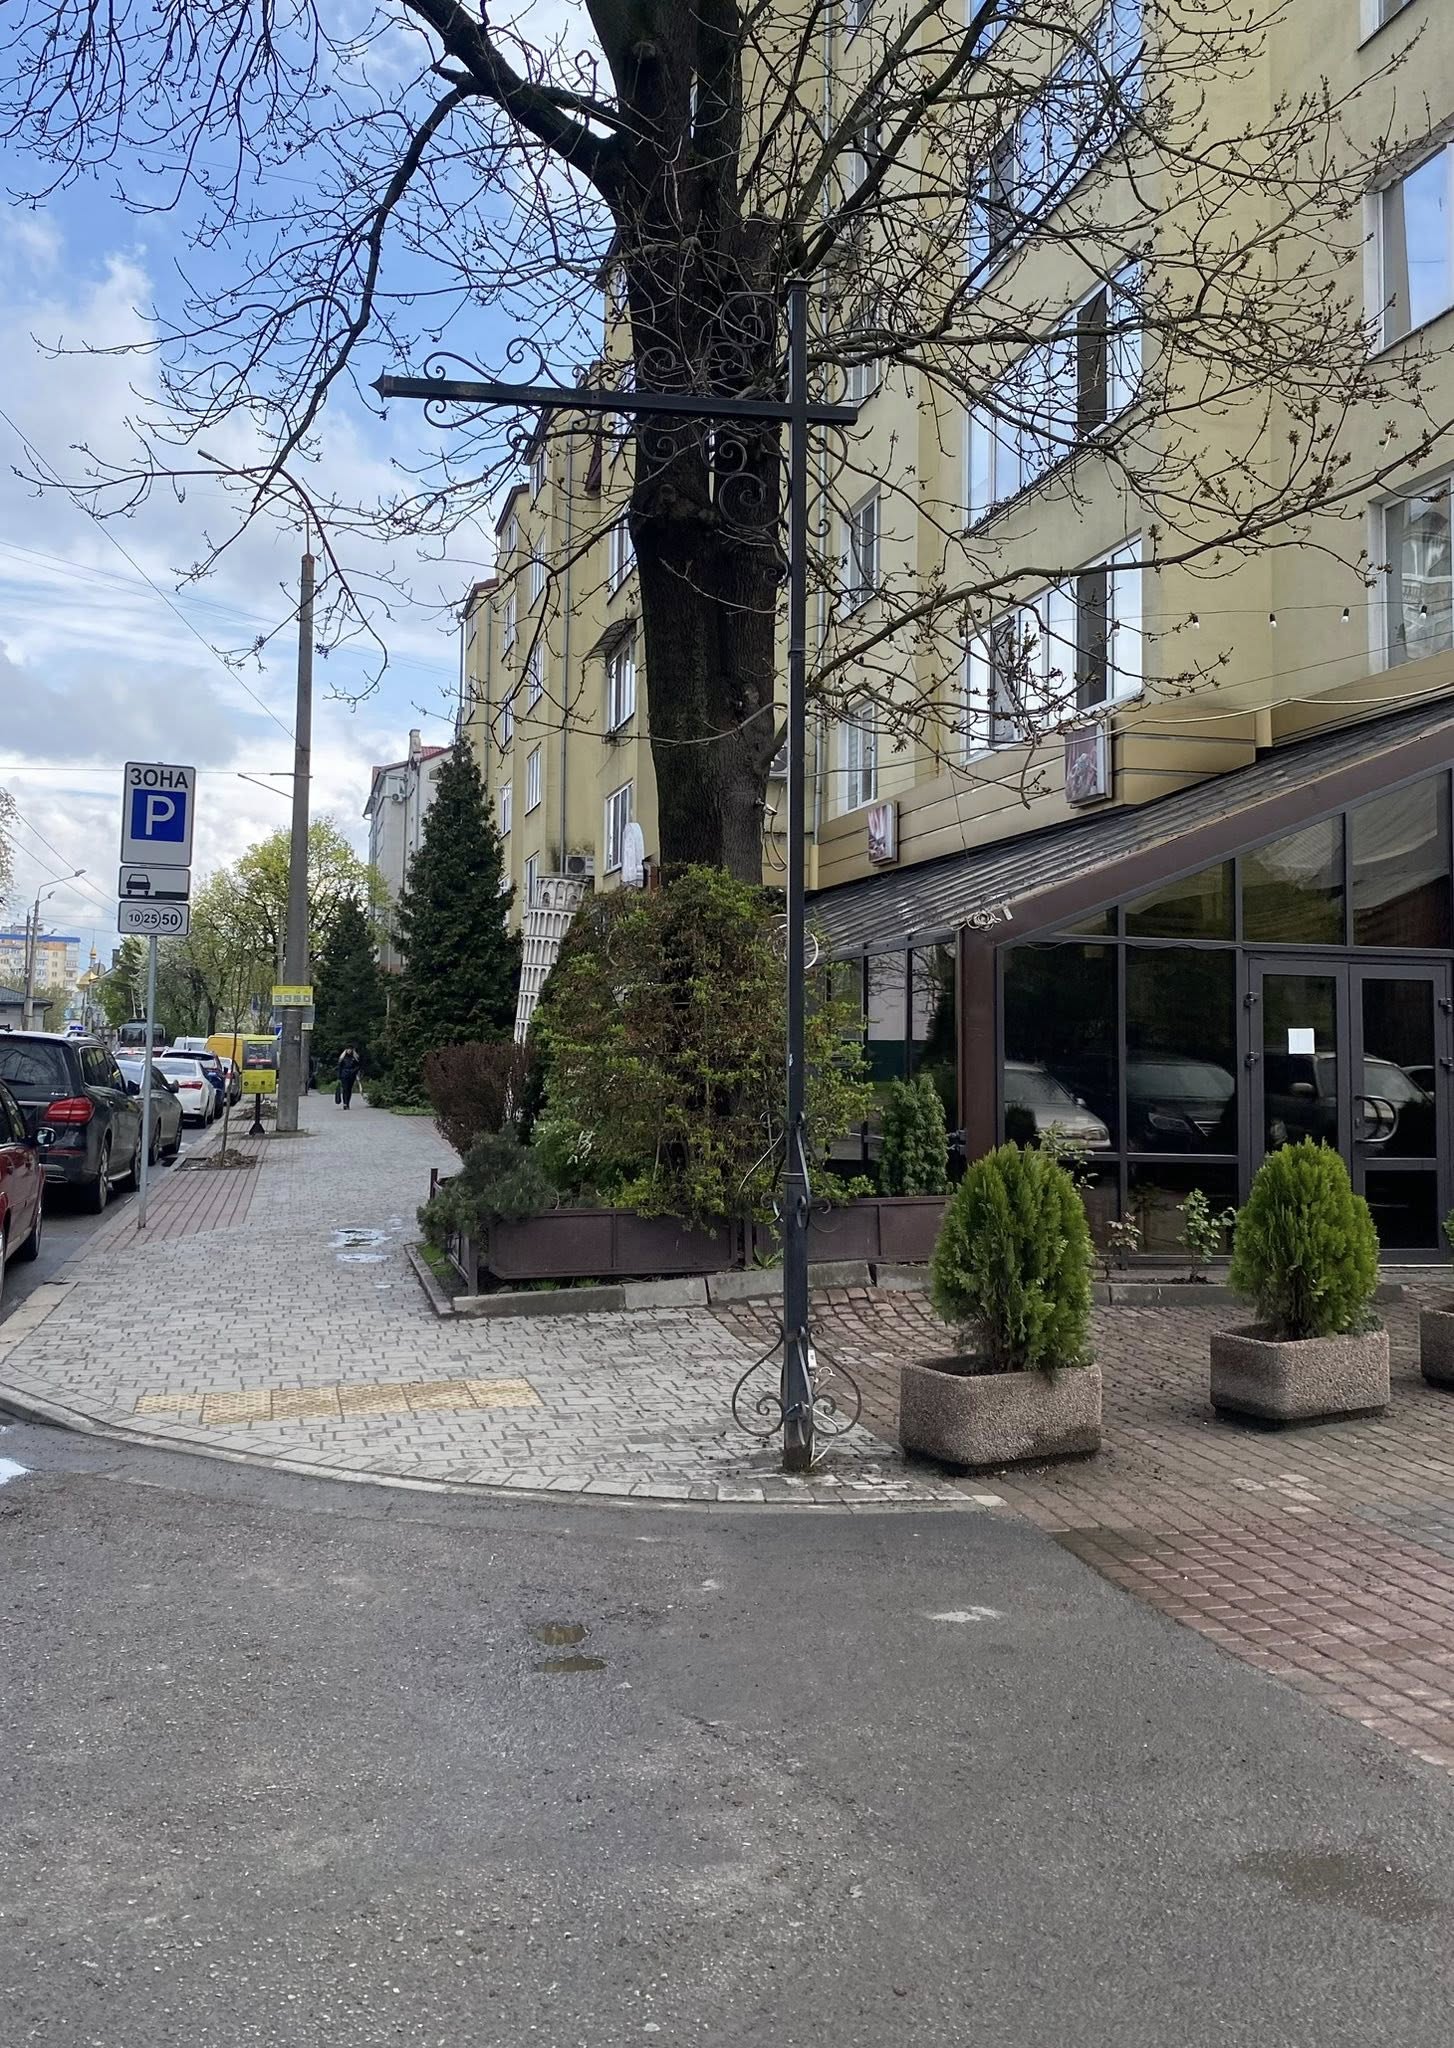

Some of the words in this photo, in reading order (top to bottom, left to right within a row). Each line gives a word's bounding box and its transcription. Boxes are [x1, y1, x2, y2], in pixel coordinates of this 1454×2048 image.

[130, 768, 189, 789] ЗОНА
[145, 794, 176, 836] P
[129, 914, 141, 922] 10
[143, 913, 158, 924] 25
[161, 914, 178, 926] 50
